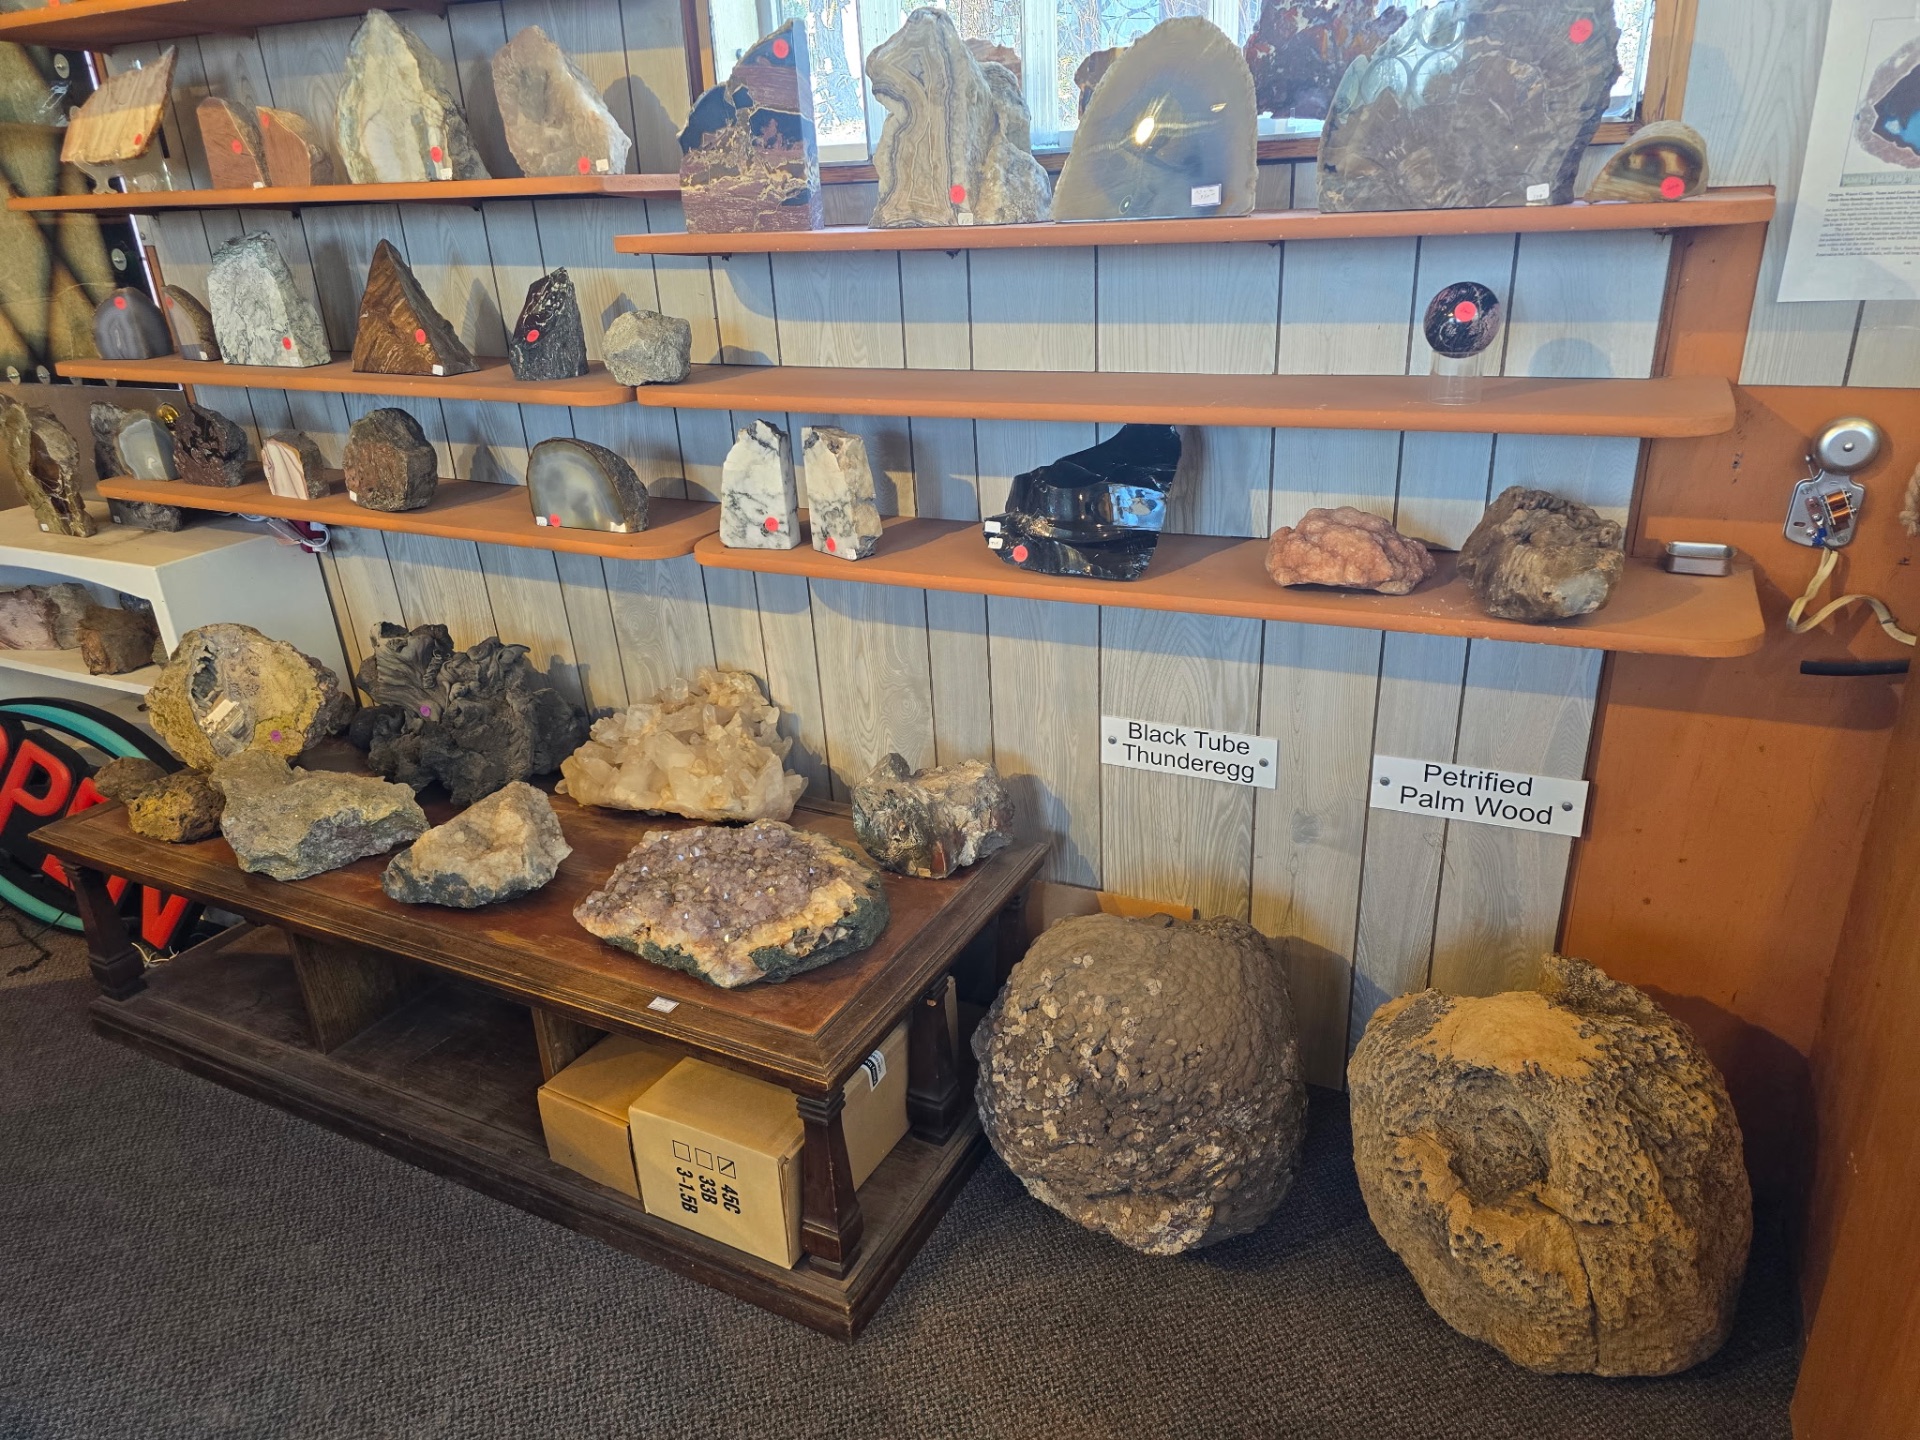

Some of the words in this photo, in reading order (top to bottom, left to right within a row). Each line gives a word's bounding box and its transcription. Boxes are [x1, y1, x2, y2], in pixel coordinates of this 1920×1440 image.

[1129, 721, 1187, 747] Black
[1194, 730, 1250, 755] Tube
[1122, 742, 1254, 783] Thunderegg
[1423, 763, 1533, 797] Petrified
[1400, 785, 1464, 813] Palm
[1475, 795, 1553, 825] Wood
[676, 1166, 699, 1214] 3-1.5B
[699, 1175, 718, 1205] 33B
[721, 1183, 741, 1214] 45C
